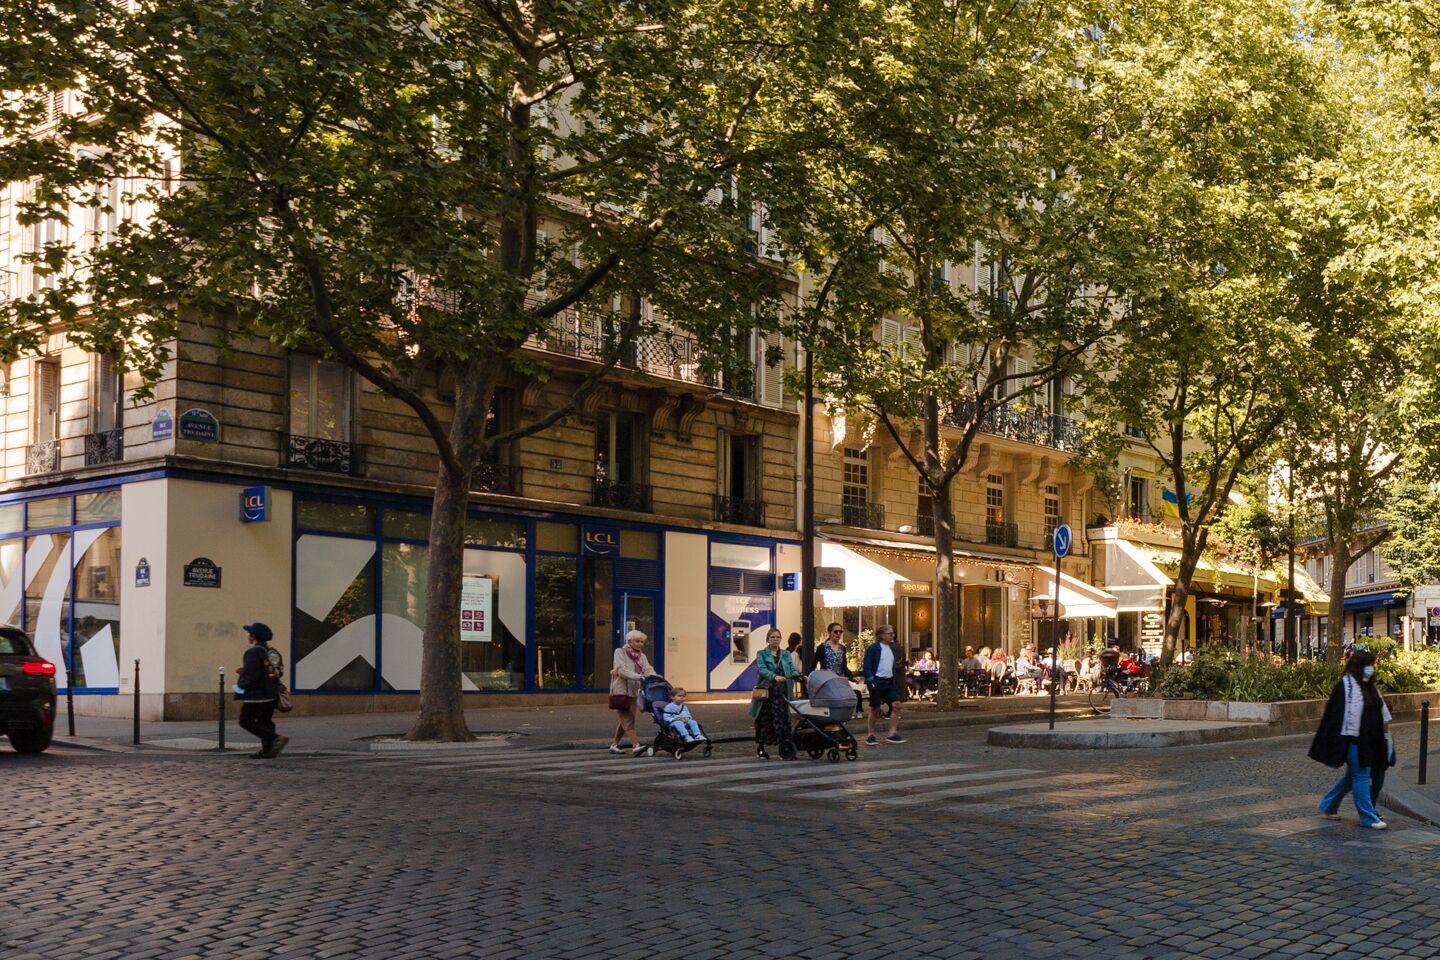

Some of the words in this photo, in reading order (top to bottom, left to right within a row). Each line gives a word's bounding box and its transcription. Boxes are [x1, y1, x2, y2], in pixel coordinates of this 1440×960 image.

[184, 429, 215, 438] TRUDAINE
[245, 495, 263, 507] LCL
[586, 531, 616, 545] LCL
[189, 572, 217, 580] TRUDAINE
[902, 583, 930, 592] season
